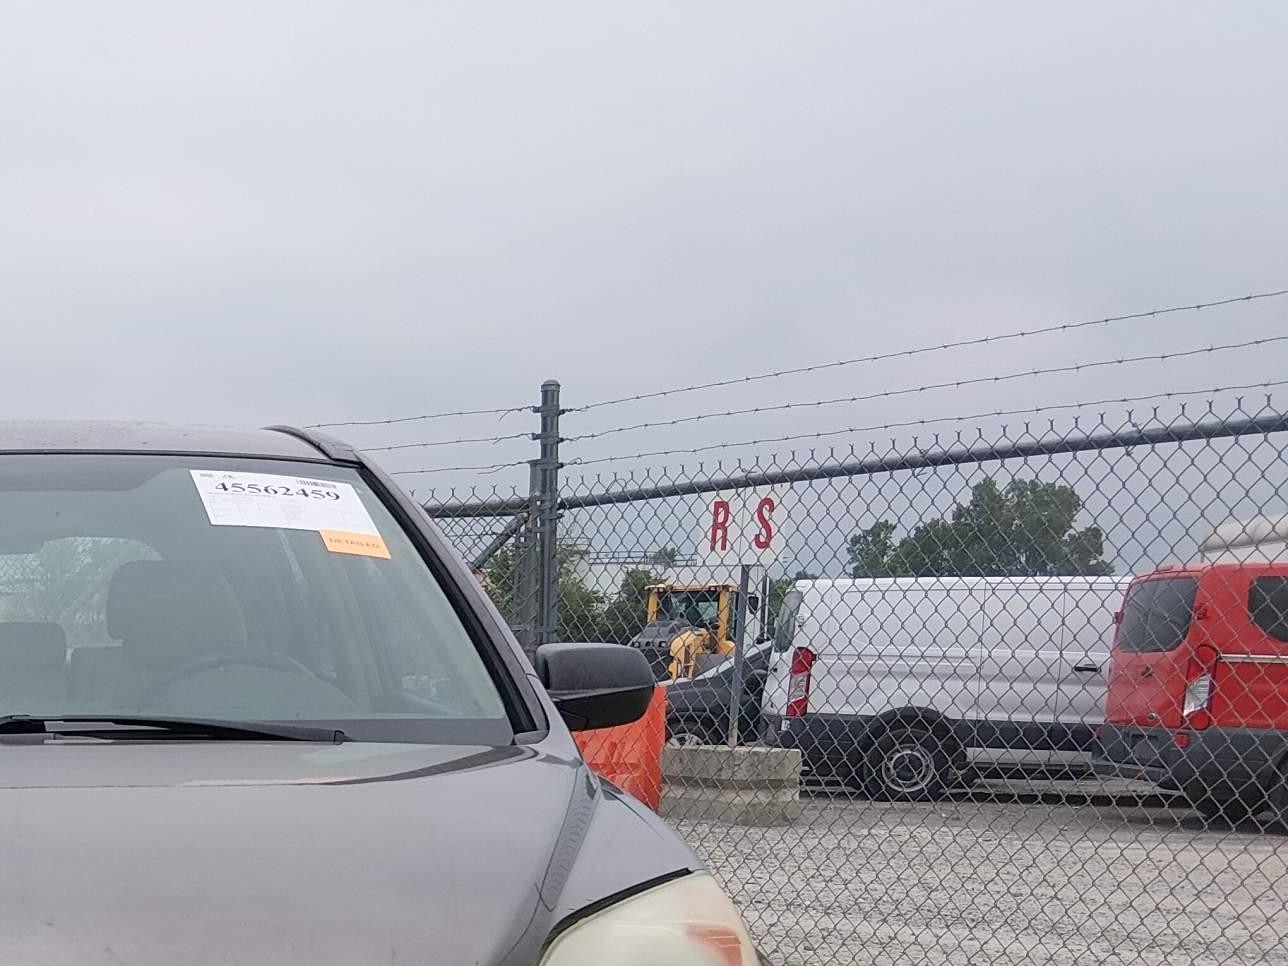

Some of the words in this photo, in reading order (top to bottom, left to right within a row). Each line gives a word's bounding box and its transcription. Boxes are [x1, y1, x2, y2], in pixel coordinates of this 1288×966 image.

[214, 481, 341, 501] 45562459
[710, 500, 730, 551] R
[754, 497, 775, 549] S
